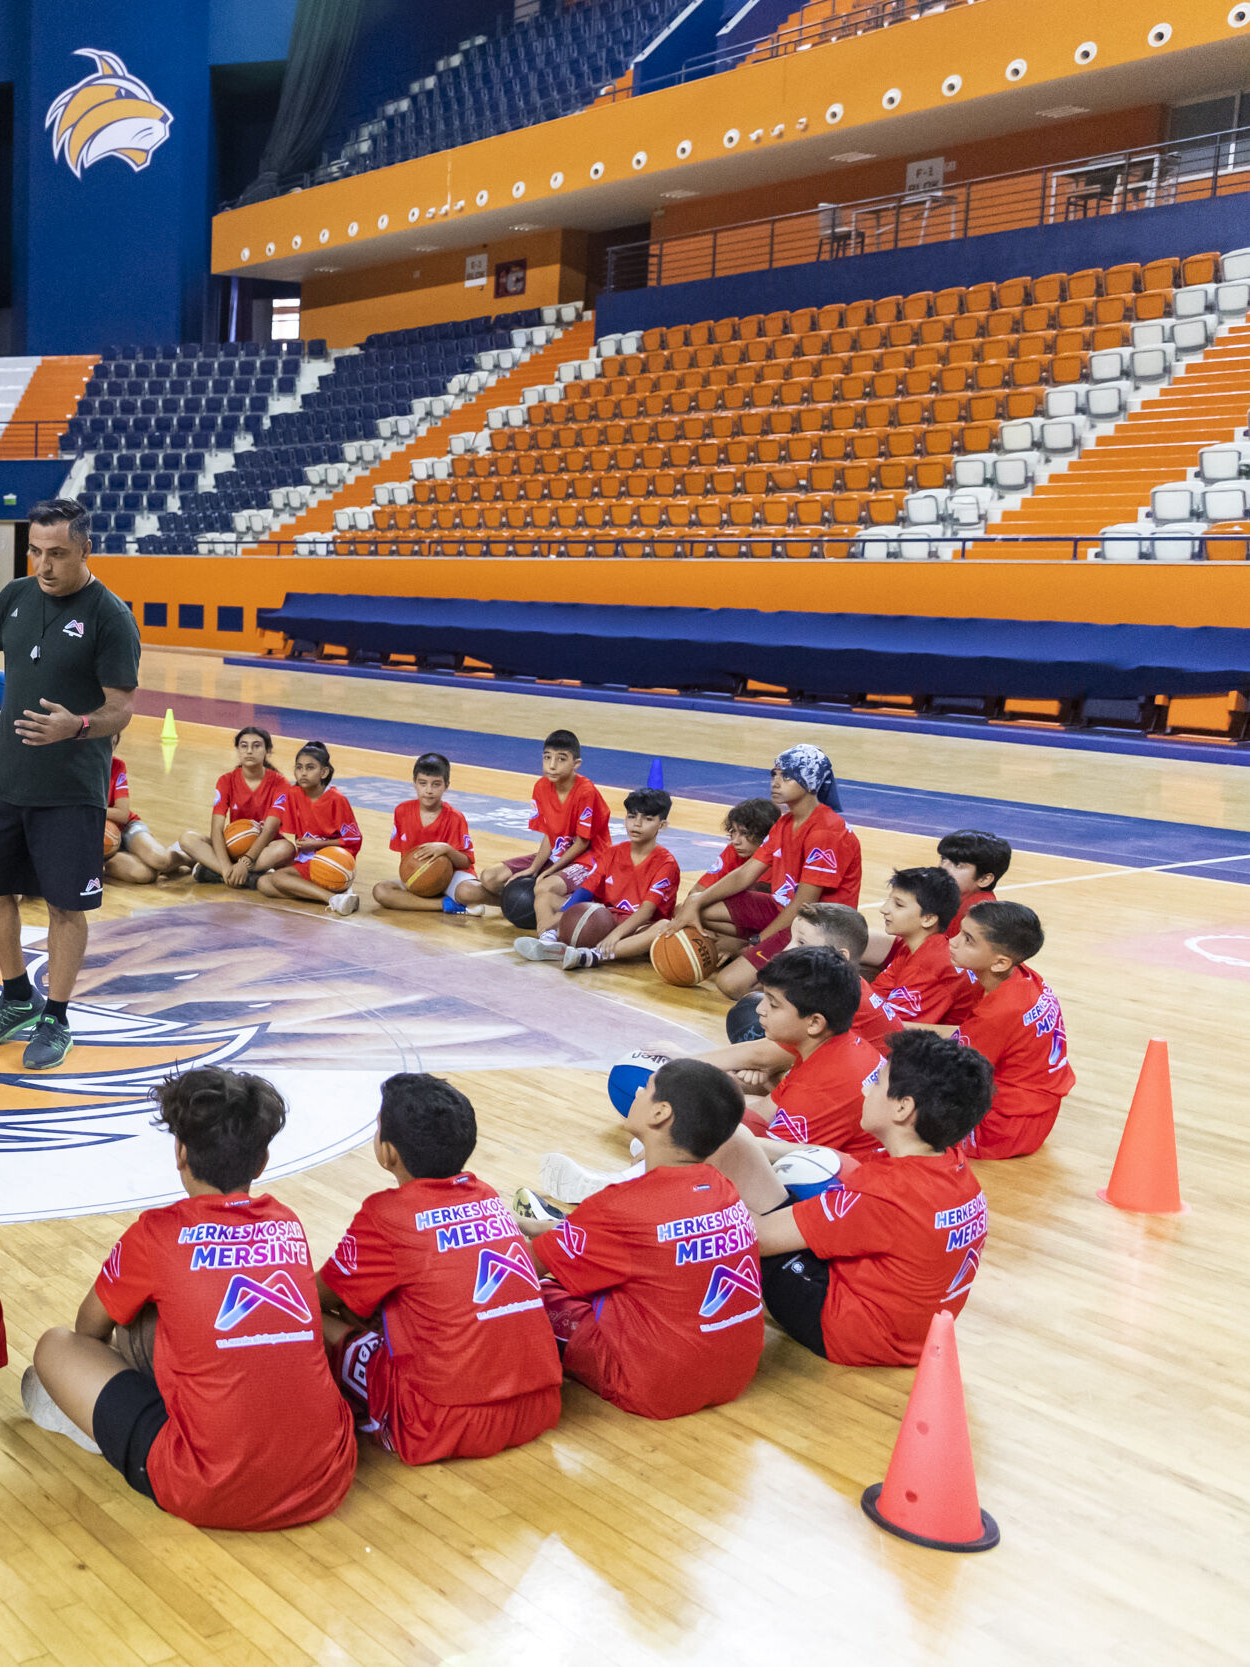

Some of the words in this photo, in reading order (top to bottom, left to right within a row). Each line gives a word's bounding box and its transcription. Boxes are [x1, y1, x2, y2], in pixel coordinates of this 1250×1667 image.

[415, 1201, 483, 1232] HERKES
[657, 1211, 723, 1243] HERKES
[934, 1199, 978, 1230] HERKES
[178, 1222, 253, 1244] HERKES
[436, 1215, 524, 1253] MERSİN
[190, 1238, 308, 1271] MERSİN'E
